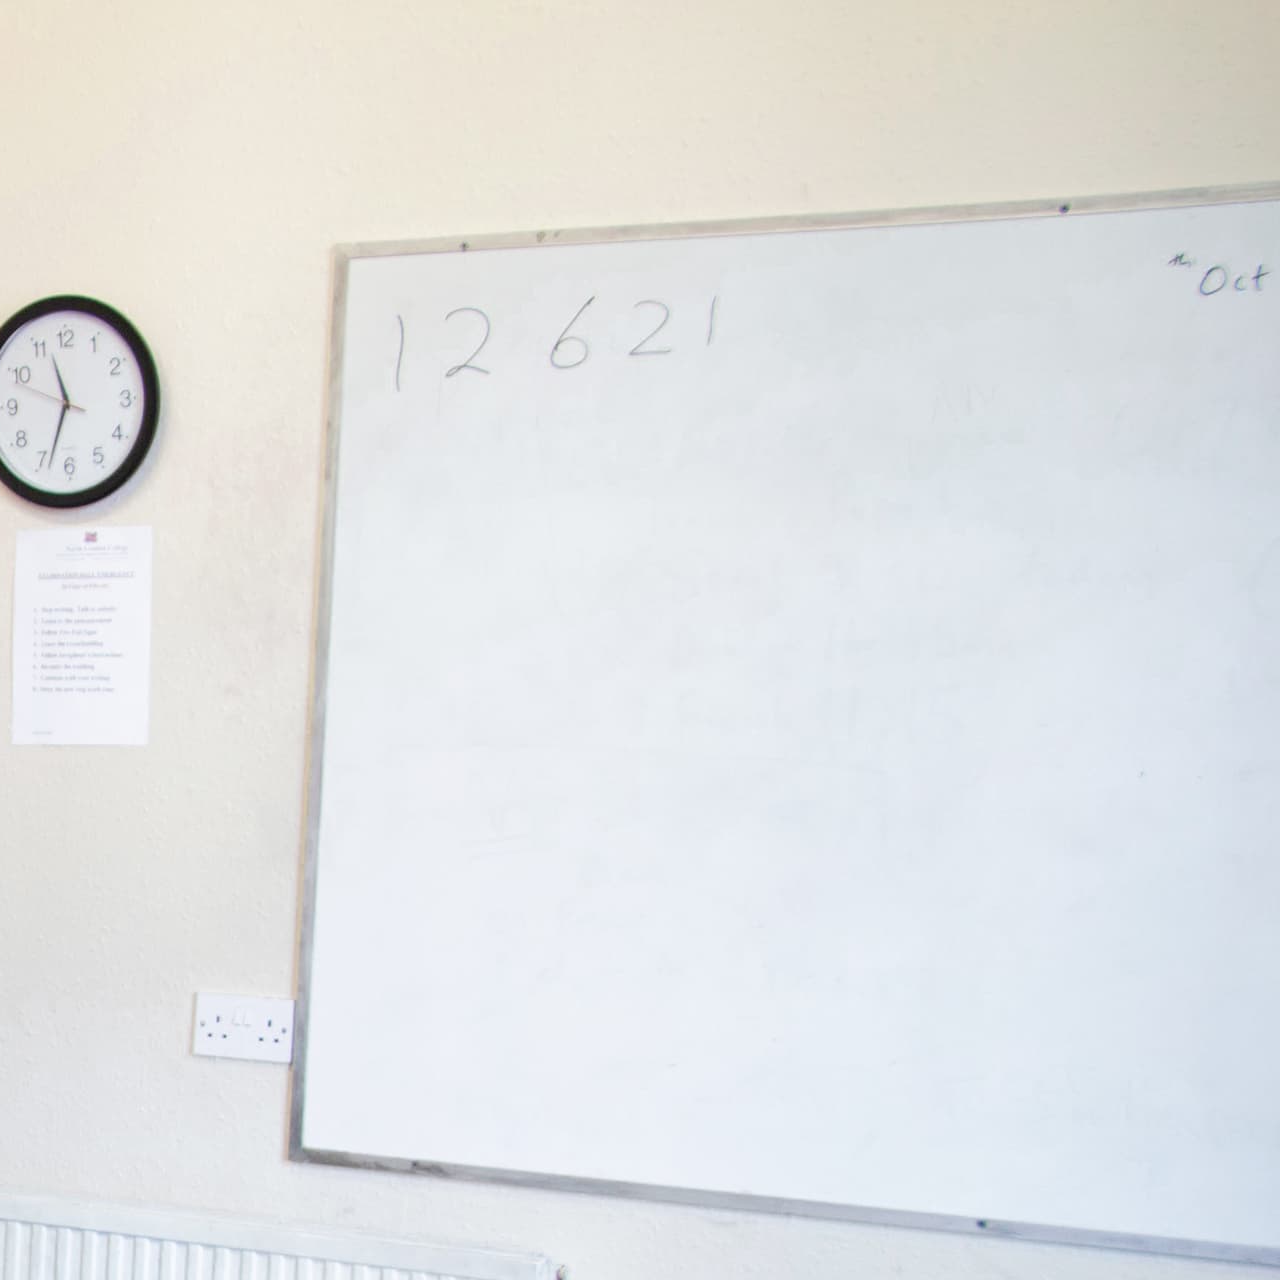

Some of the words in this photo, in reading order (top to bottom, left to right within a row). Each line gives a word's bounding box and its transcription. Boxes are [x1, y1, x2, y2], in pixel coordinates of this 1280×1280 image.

[1199, 263, 1271, 296] Oct
[56, 329, 75, 348] 12
[91, 336, 97, 353] 1
[33, 340, 47, 358] 11
[13, 365, 32, 385] 10
[109, 356, 121, 376] 2
[6, 398, 18, 416] 9
[120, 389, 132, 408] 3
[15, 429, 28, 448] 8
[111, 423, 122, 441] 4
[37, 450, 48, 469] 7
[92, 446, 104, 464] 5
[63, 457, 75, 476] 6
